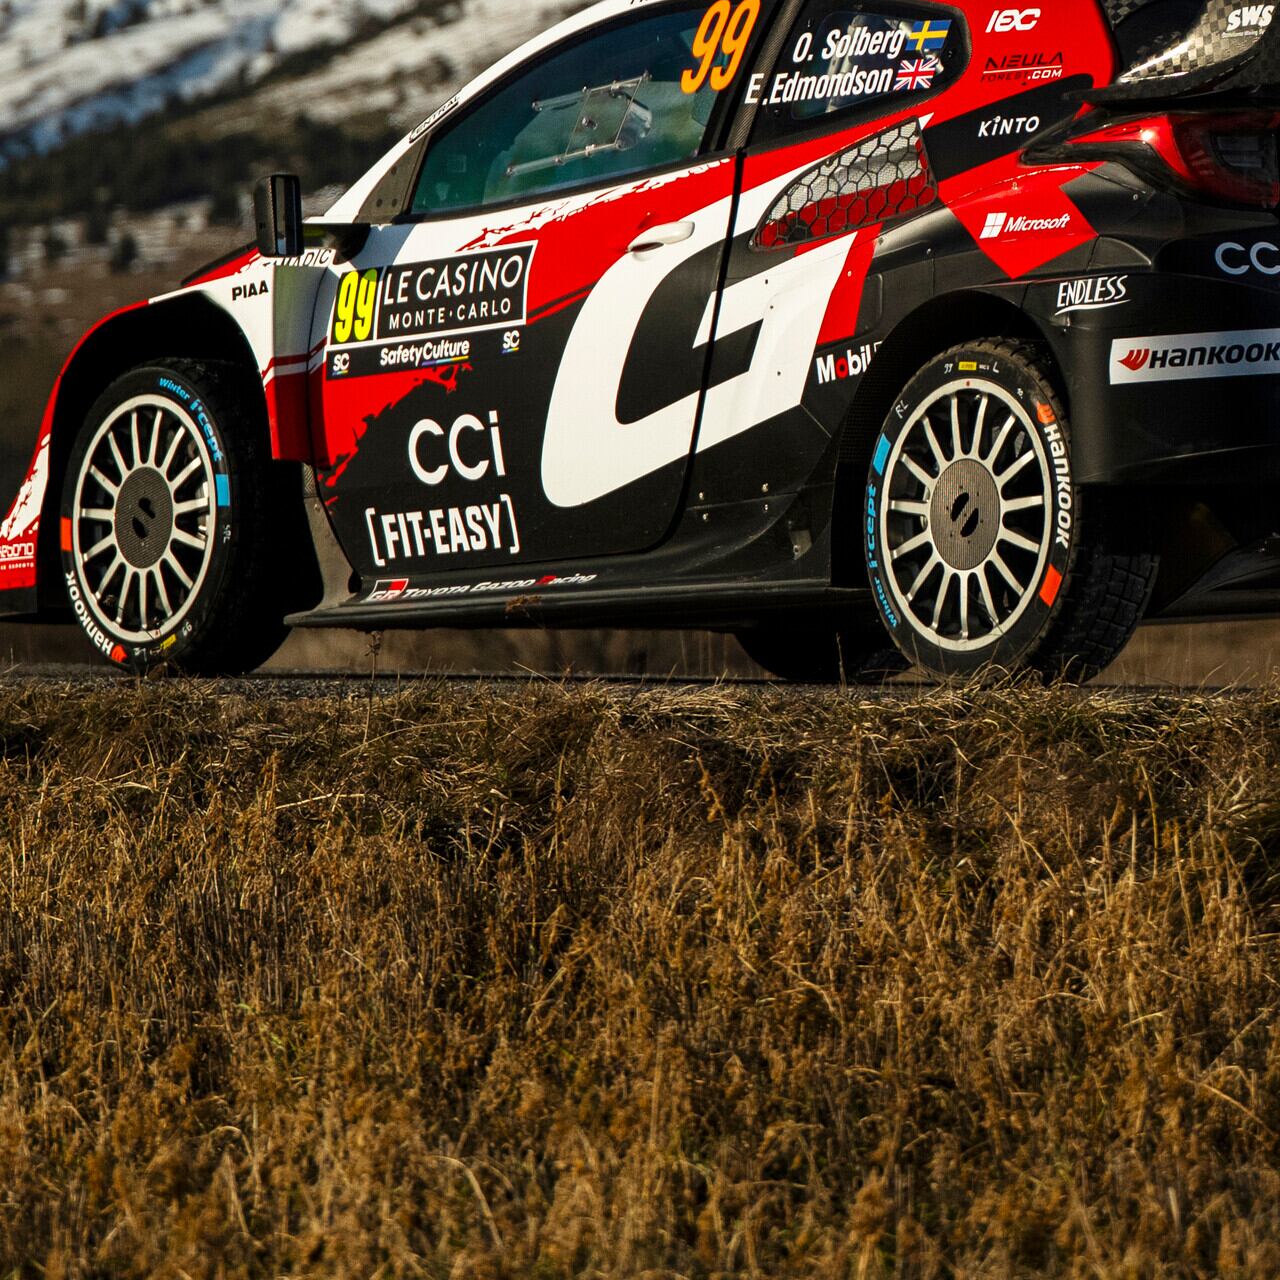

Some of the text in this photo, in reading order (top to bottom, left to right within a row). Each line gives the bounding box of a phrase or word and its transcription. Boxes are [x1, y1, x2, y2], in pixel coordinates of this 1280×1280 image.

[1226, 4, 1275, 32] SWS
[792, 25, 906, 63] O. Solberg
[1004, 213, 1071, 233] Microsoft
[231, 279, 269, 301] PIAA
[383, 254, 523, 306] LE CASINO
[1056, 274, 1129, 308] ENDLESS
[334, 267, 377, 343] 99
[380, 339, 470, 367] SafetyCulture
[503, 330, 520, 350] SC
[332, 353, 350, 372] SC
[816, 344, 872, 385] Mobil
[402, 584, 470, 599] TOYOTA
[470, 579, 537, 593] GAZOO
[536, 572, 598, 586] Racing
